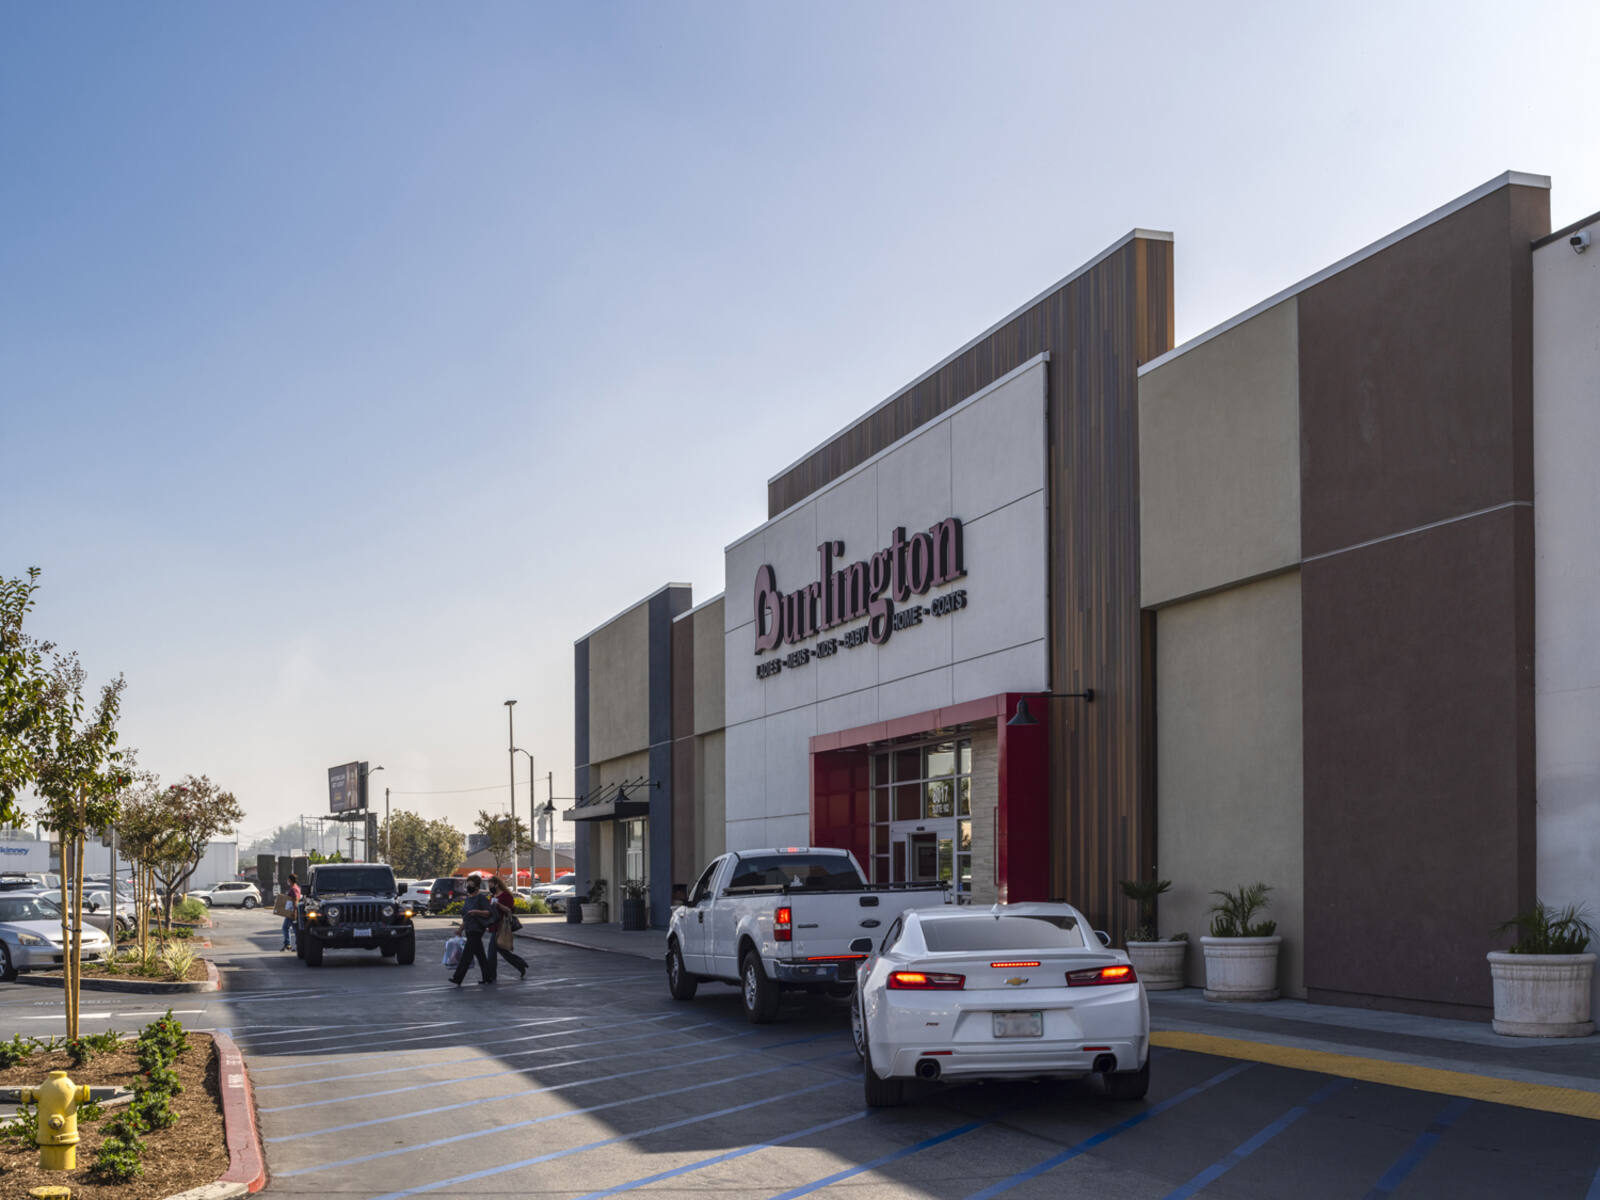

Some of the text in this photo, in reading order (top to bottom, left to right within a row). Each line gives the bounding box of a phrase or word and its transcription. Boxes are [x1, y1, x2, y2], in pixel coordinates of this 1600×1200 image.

[754, 518, 967, 655] Burlington
[817, 638, 837, 658] KIDS
[844, 626, 868, 648] BABY
[893, 605, 923, 631] HOME
[931, 589, 967, 617] COATS
